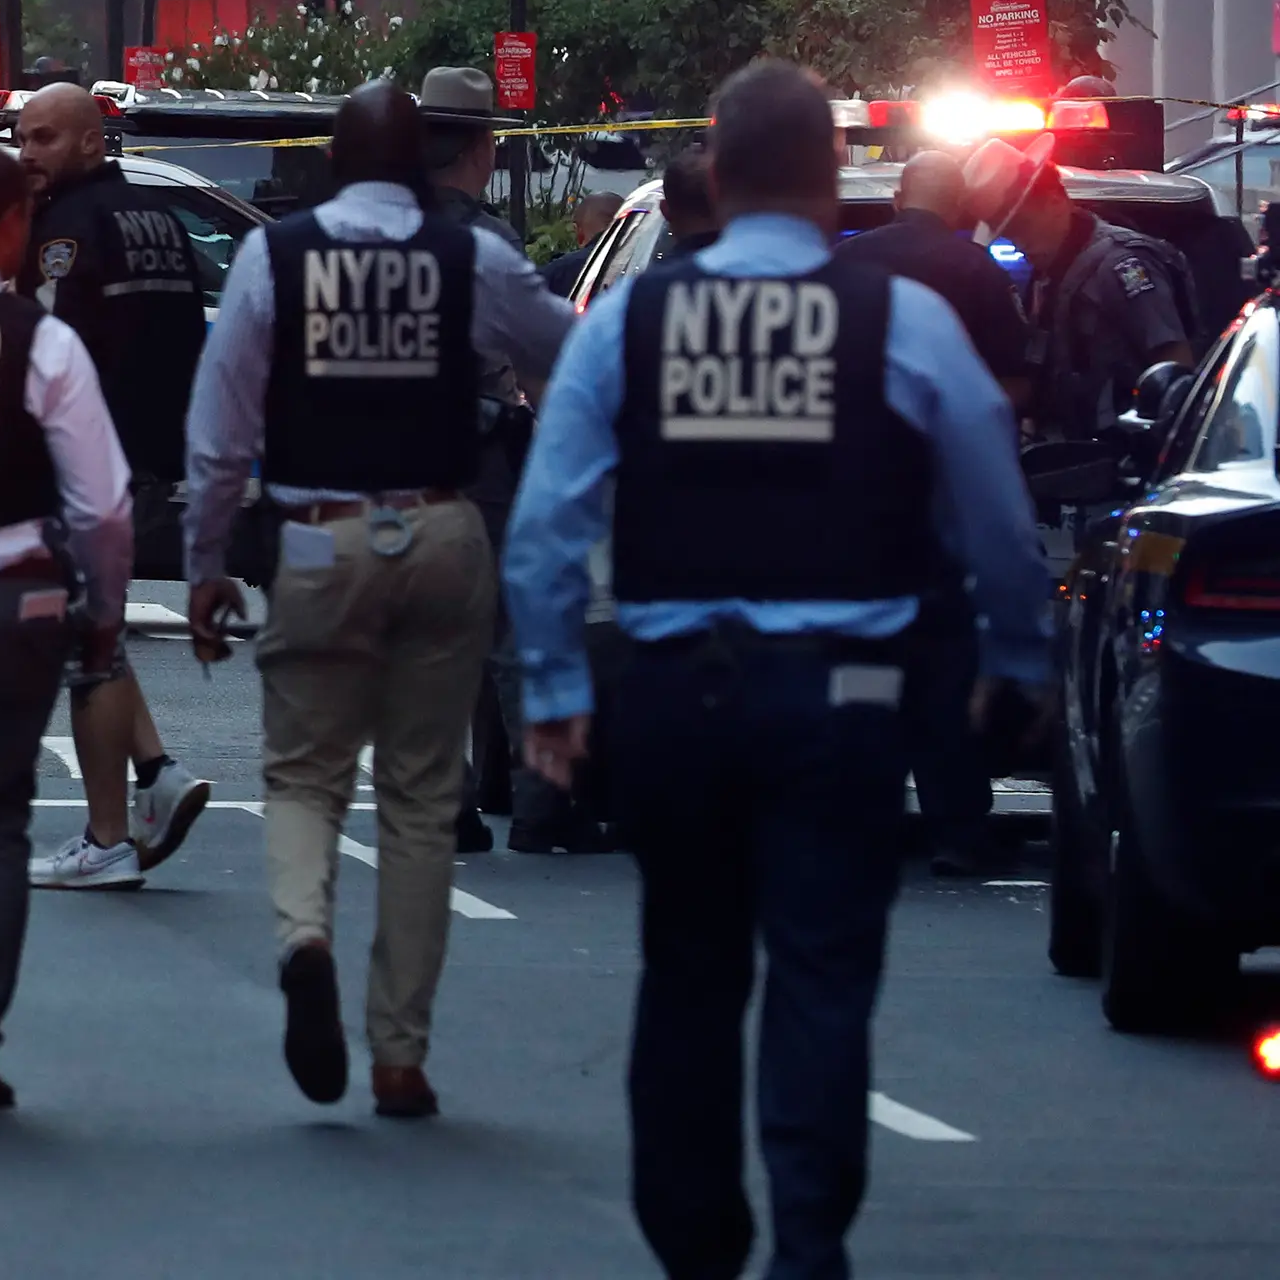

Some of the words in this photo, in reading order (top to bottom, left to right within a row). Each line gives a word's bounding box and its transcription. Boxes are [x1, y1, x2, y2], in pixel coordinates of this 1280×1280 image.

[978, 14, 994, 24] NO
[996, 10, 1039, 22] PARKING
[1015, 57, 1041, 65] TOWED
[125, 248, 187, 272] POLIC
[304, 249, 440, 312] NYPD
[305, 313, 440, 360] POLICE
[662, 279, 840, 356] NYPD
[660, 355, 837, 416] POLICE
